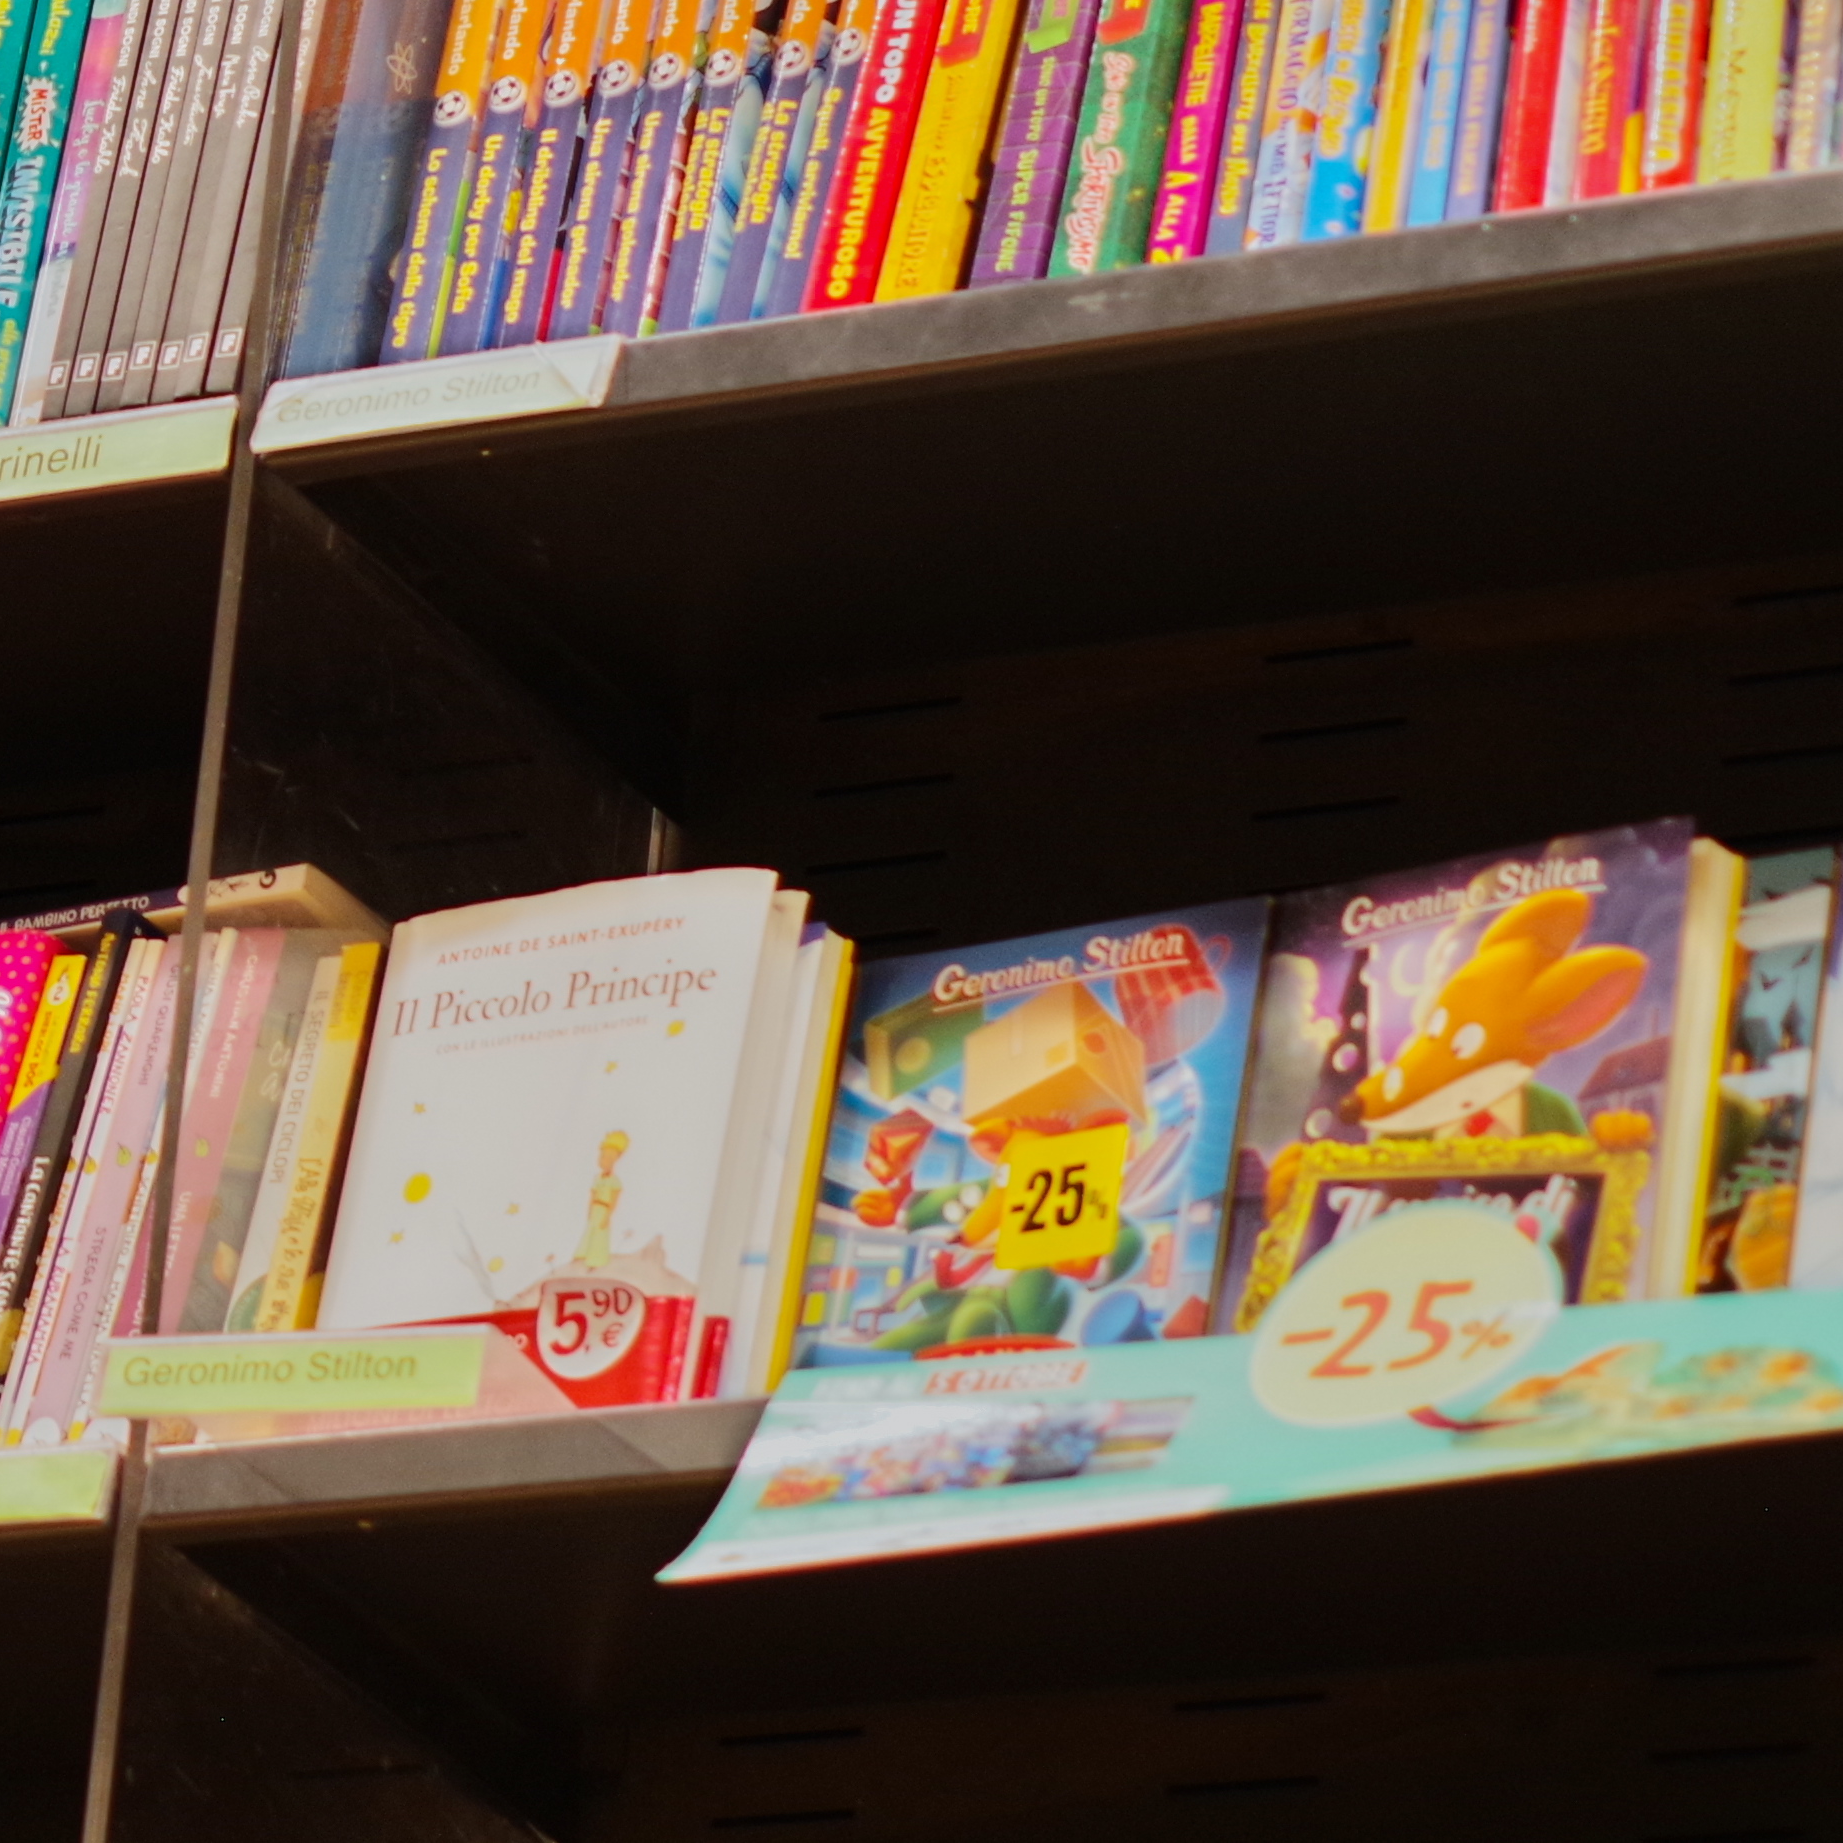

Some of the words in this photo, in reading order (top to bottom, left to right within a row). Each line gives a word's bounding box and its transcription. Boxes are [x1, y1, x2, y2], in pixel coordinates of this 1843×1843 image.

[874, 21, 908, 105] TOPO
[828, 106, 892, 301] AVVENTUROSO
[442, 369, 541, 405] Stilton
[1341, 880, 1487, 936] Geronimo
[1496, 857, 1601, 898] Stilton
[437, 946, 514, 966] ANTOINE
[520, 936, 540, 955] DE
[546, 916, 686, 952] SAINT-EXUPÉRY
[932, 962, 1074, 1004] Geronimo
[1084, 928, 1185, 971] Stilton
[391, 999, 423, 1037] Il
[427, 984, 551, 1033] Piccolo
[567, 958, 716, 1017] Principe
[123, 1354, 293, 1388] Geronimo
[306, 1352, 416, 1382] Stilton
[1279, 1280, 1510, 1381] -25%
